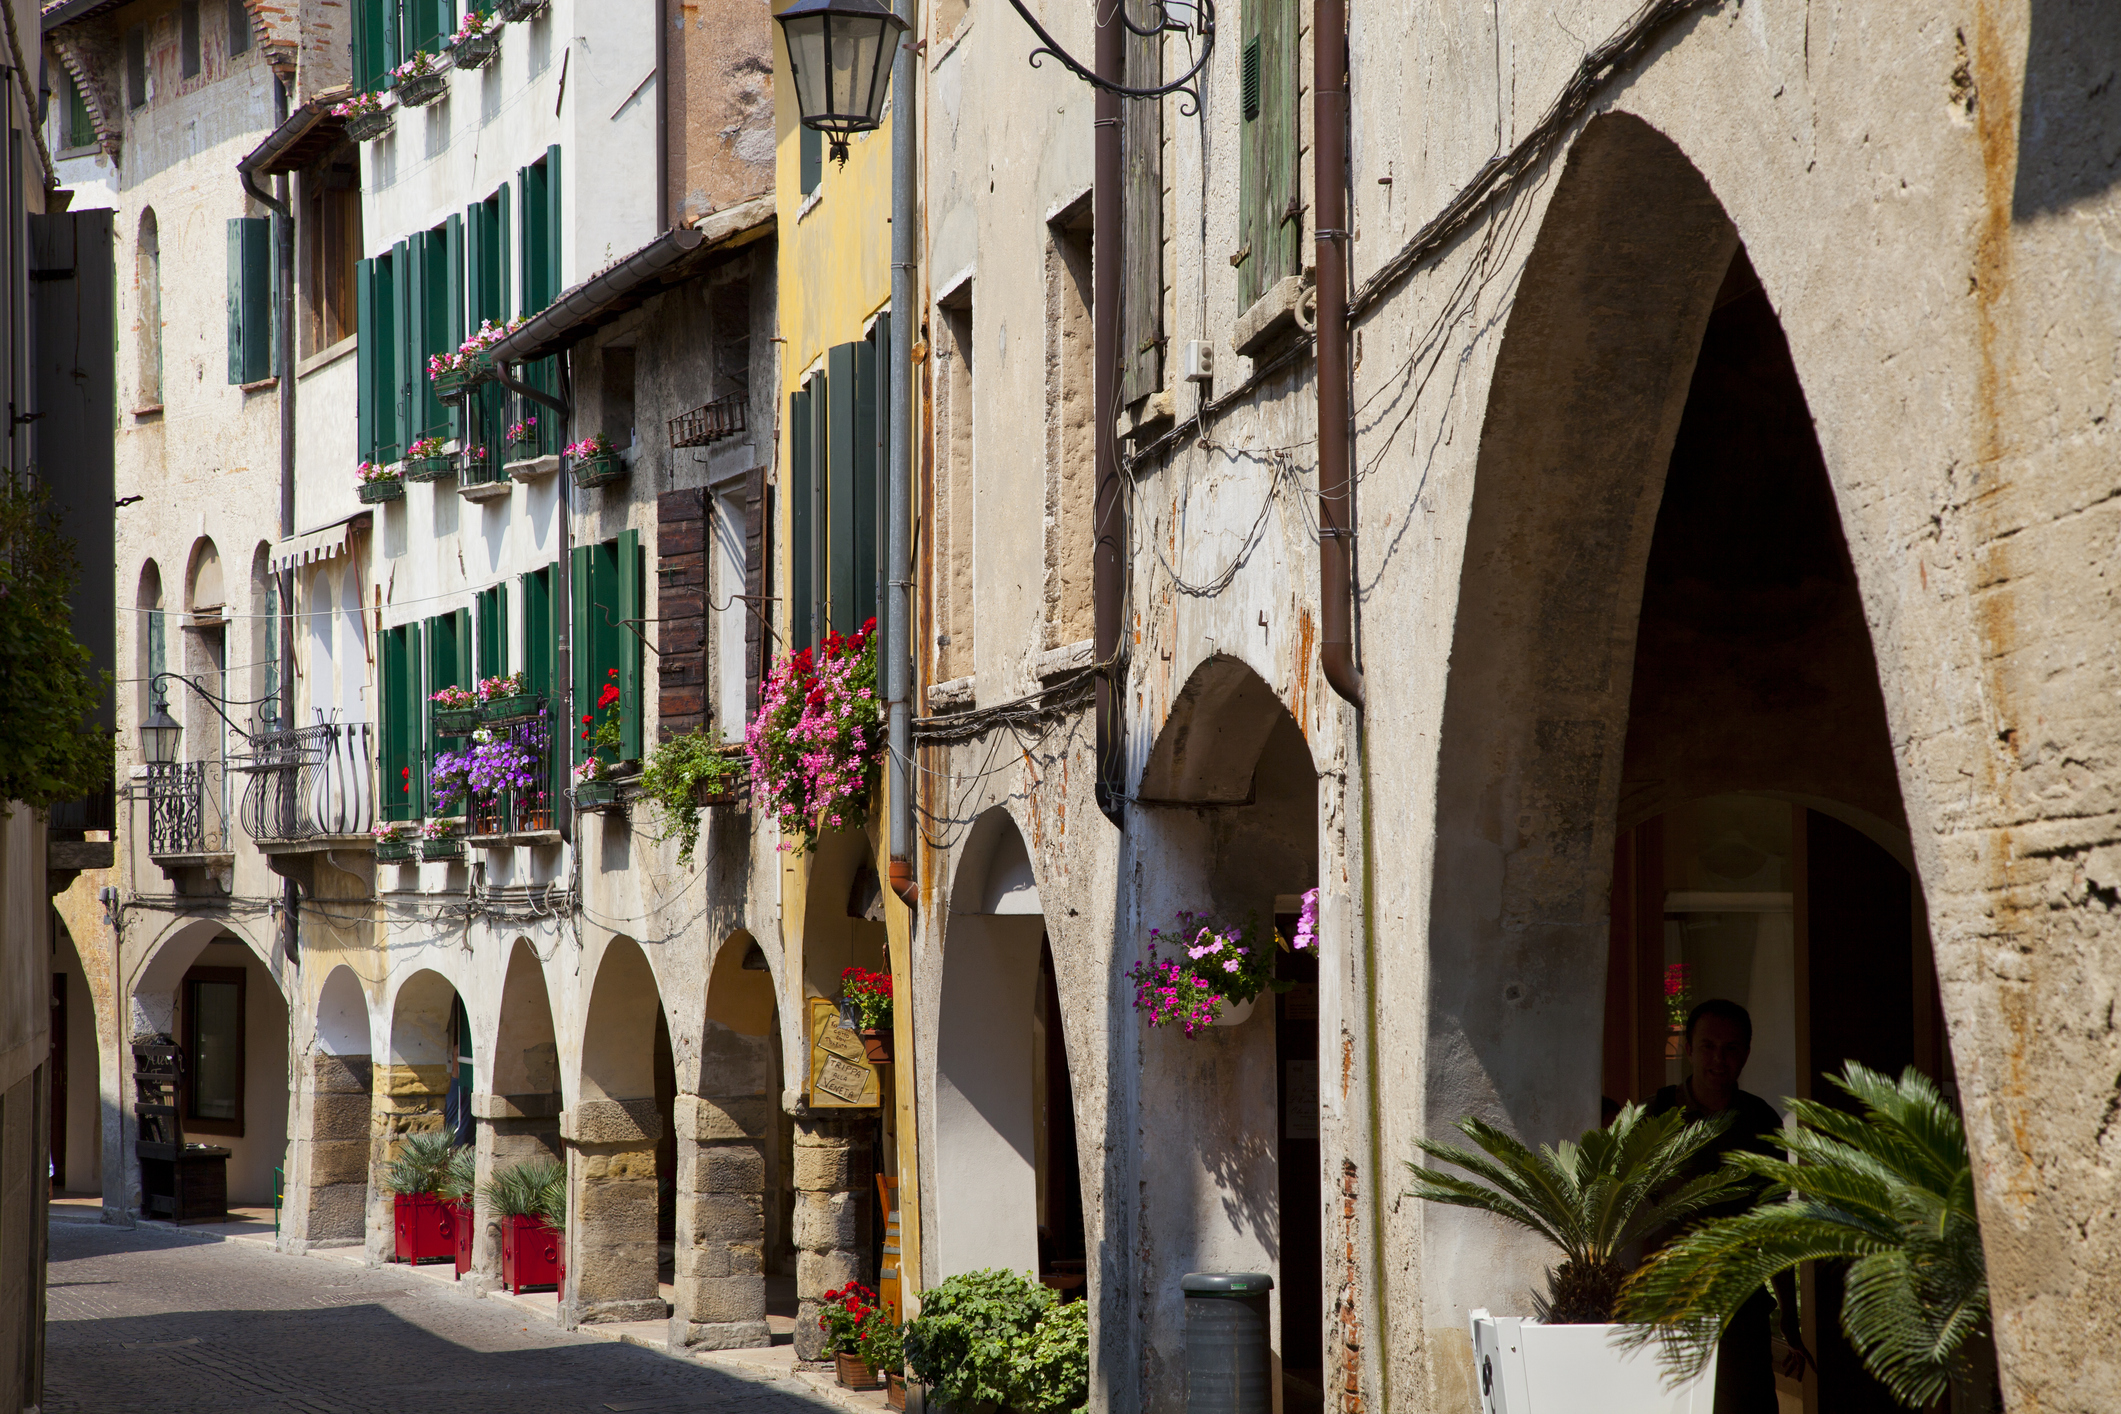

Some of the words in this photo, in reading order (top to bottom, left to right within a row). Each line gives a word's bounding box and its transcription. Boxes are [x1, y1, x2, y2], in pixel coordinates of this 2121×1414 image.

[831, 1060, 861, 1079] TRIPPA
[833, 1072, 848, 1082] ALLA
[824, 1077, 854, 1099] VENETA
